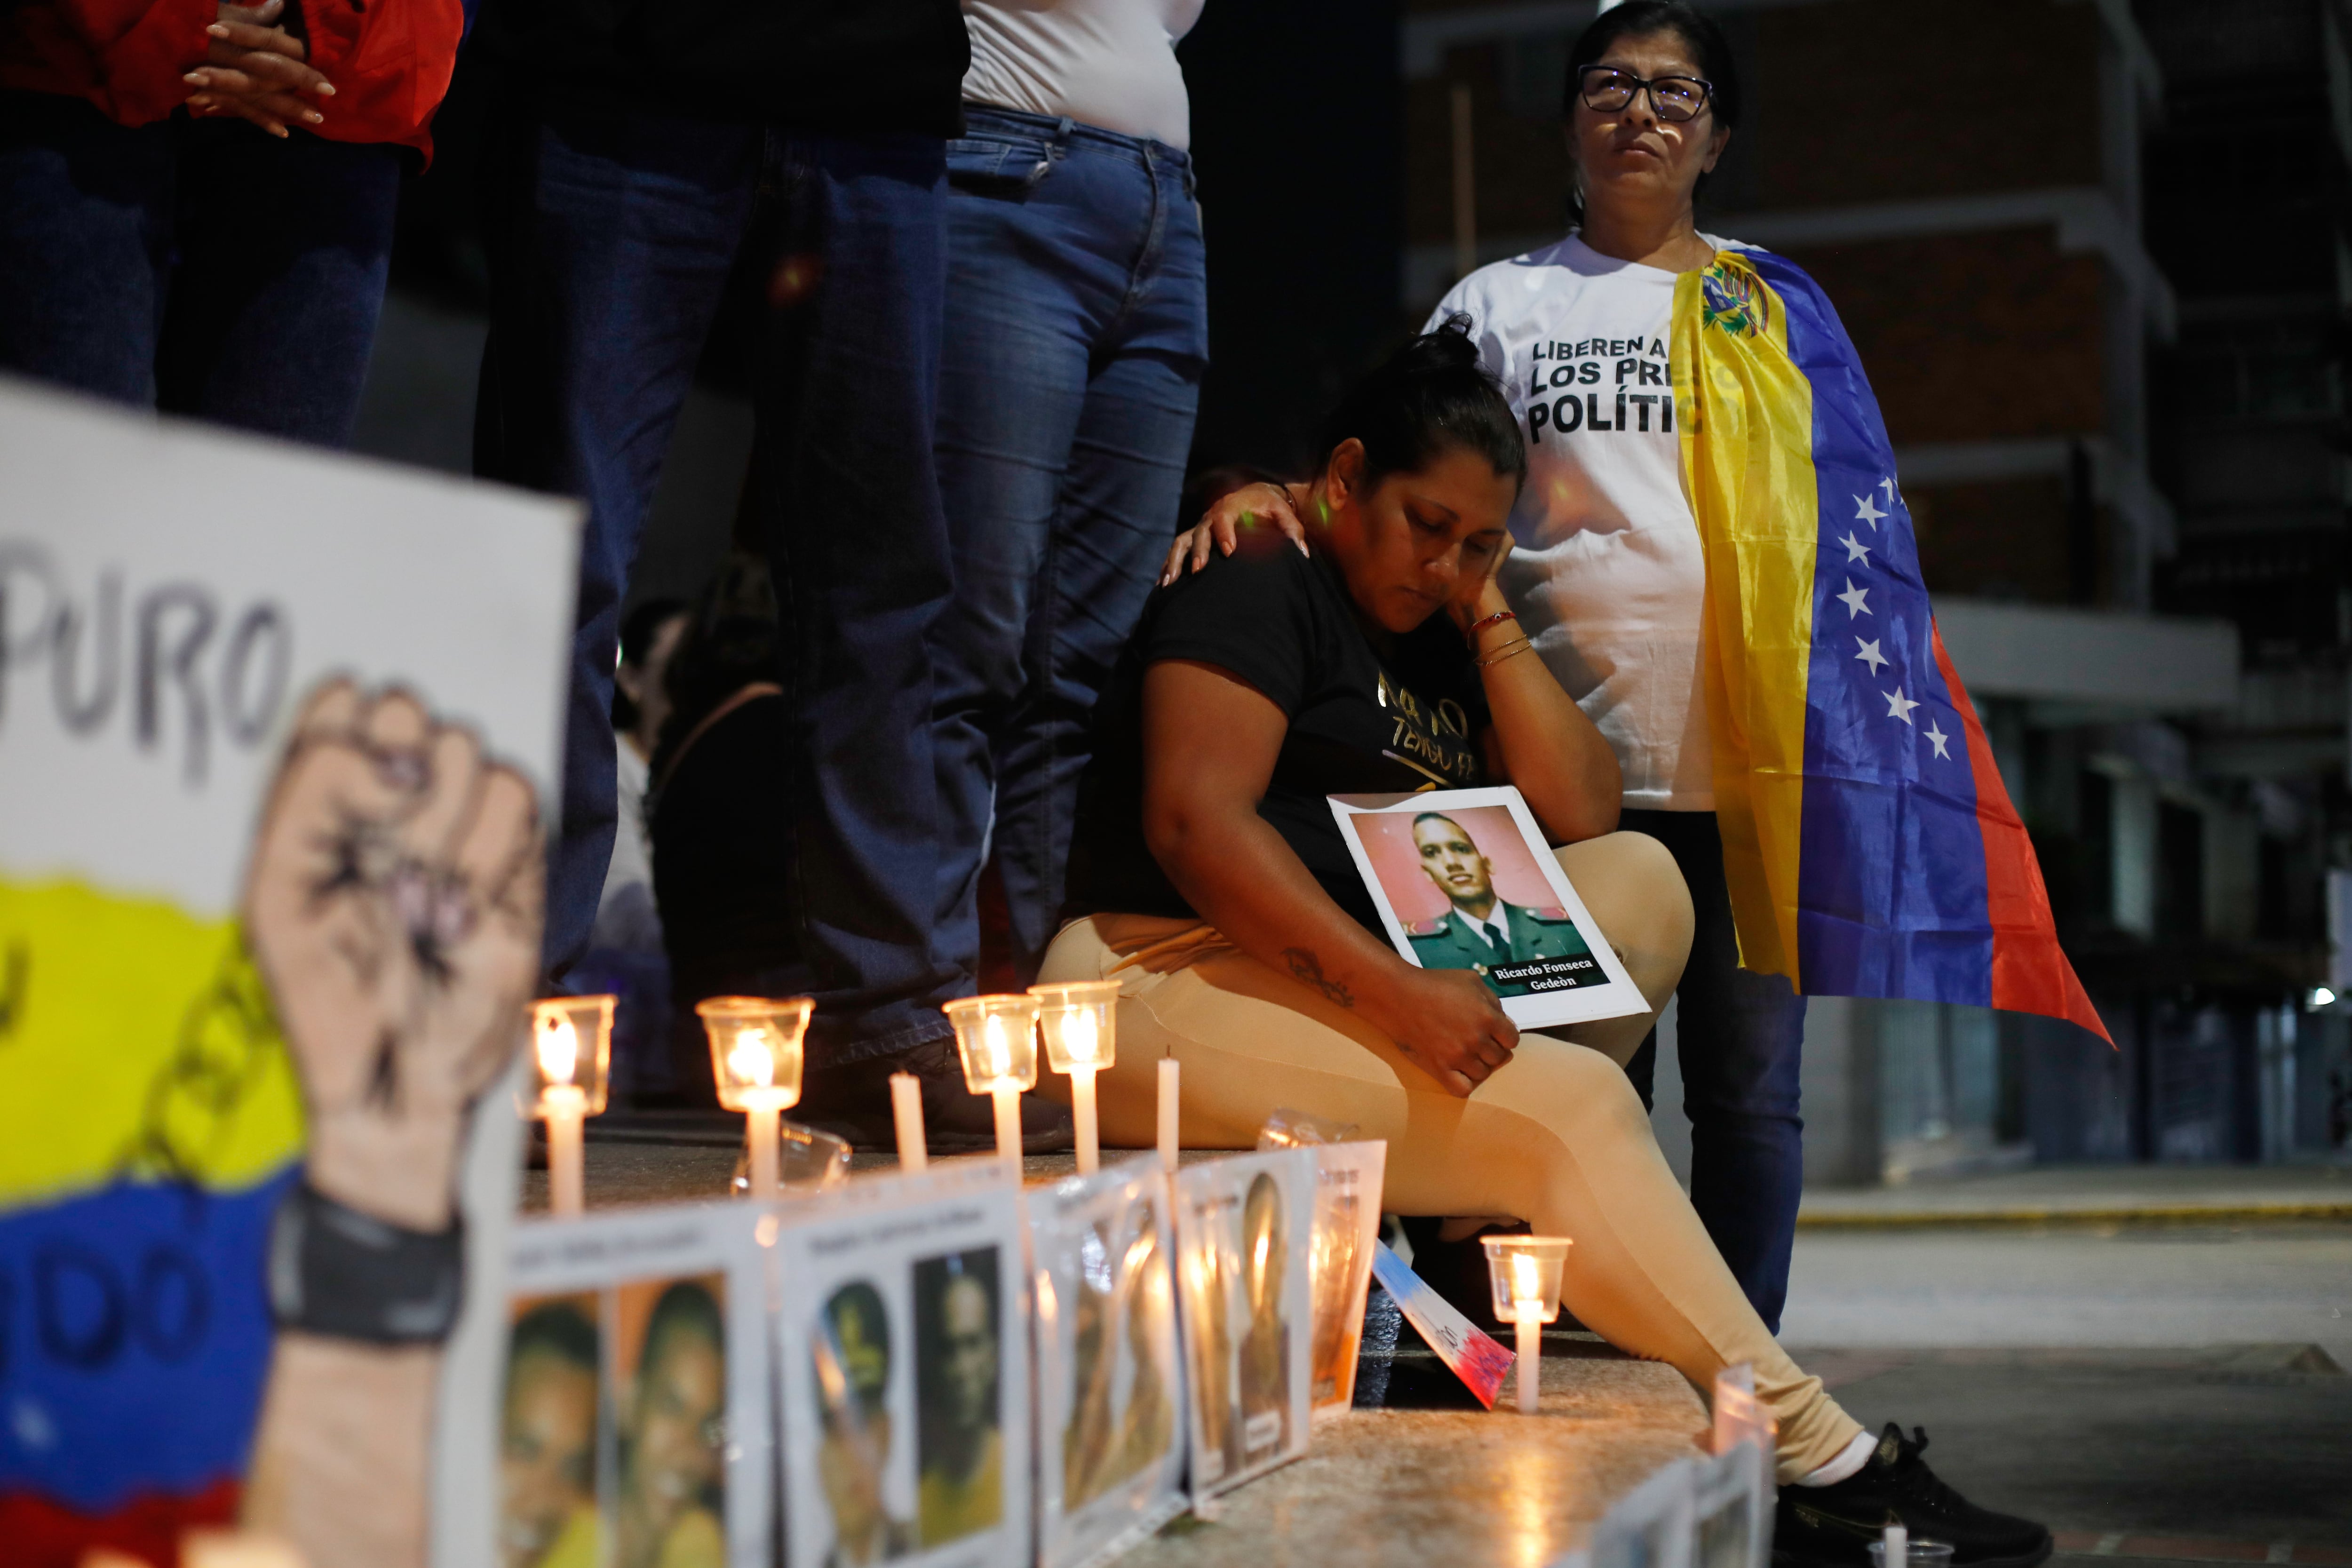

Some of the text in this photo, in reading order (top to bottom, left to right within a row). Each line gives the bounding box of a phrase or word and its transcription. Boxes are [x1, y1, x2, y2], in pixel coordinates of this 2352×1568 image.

[1533, 336, 1667, 360] LIBEREN A
[1531, 362, 1601, 396] LOS
[1494, 960, 1593, 980] Ricardo Fonseca
[1530, 976, 1577, 990] Gedeòn
